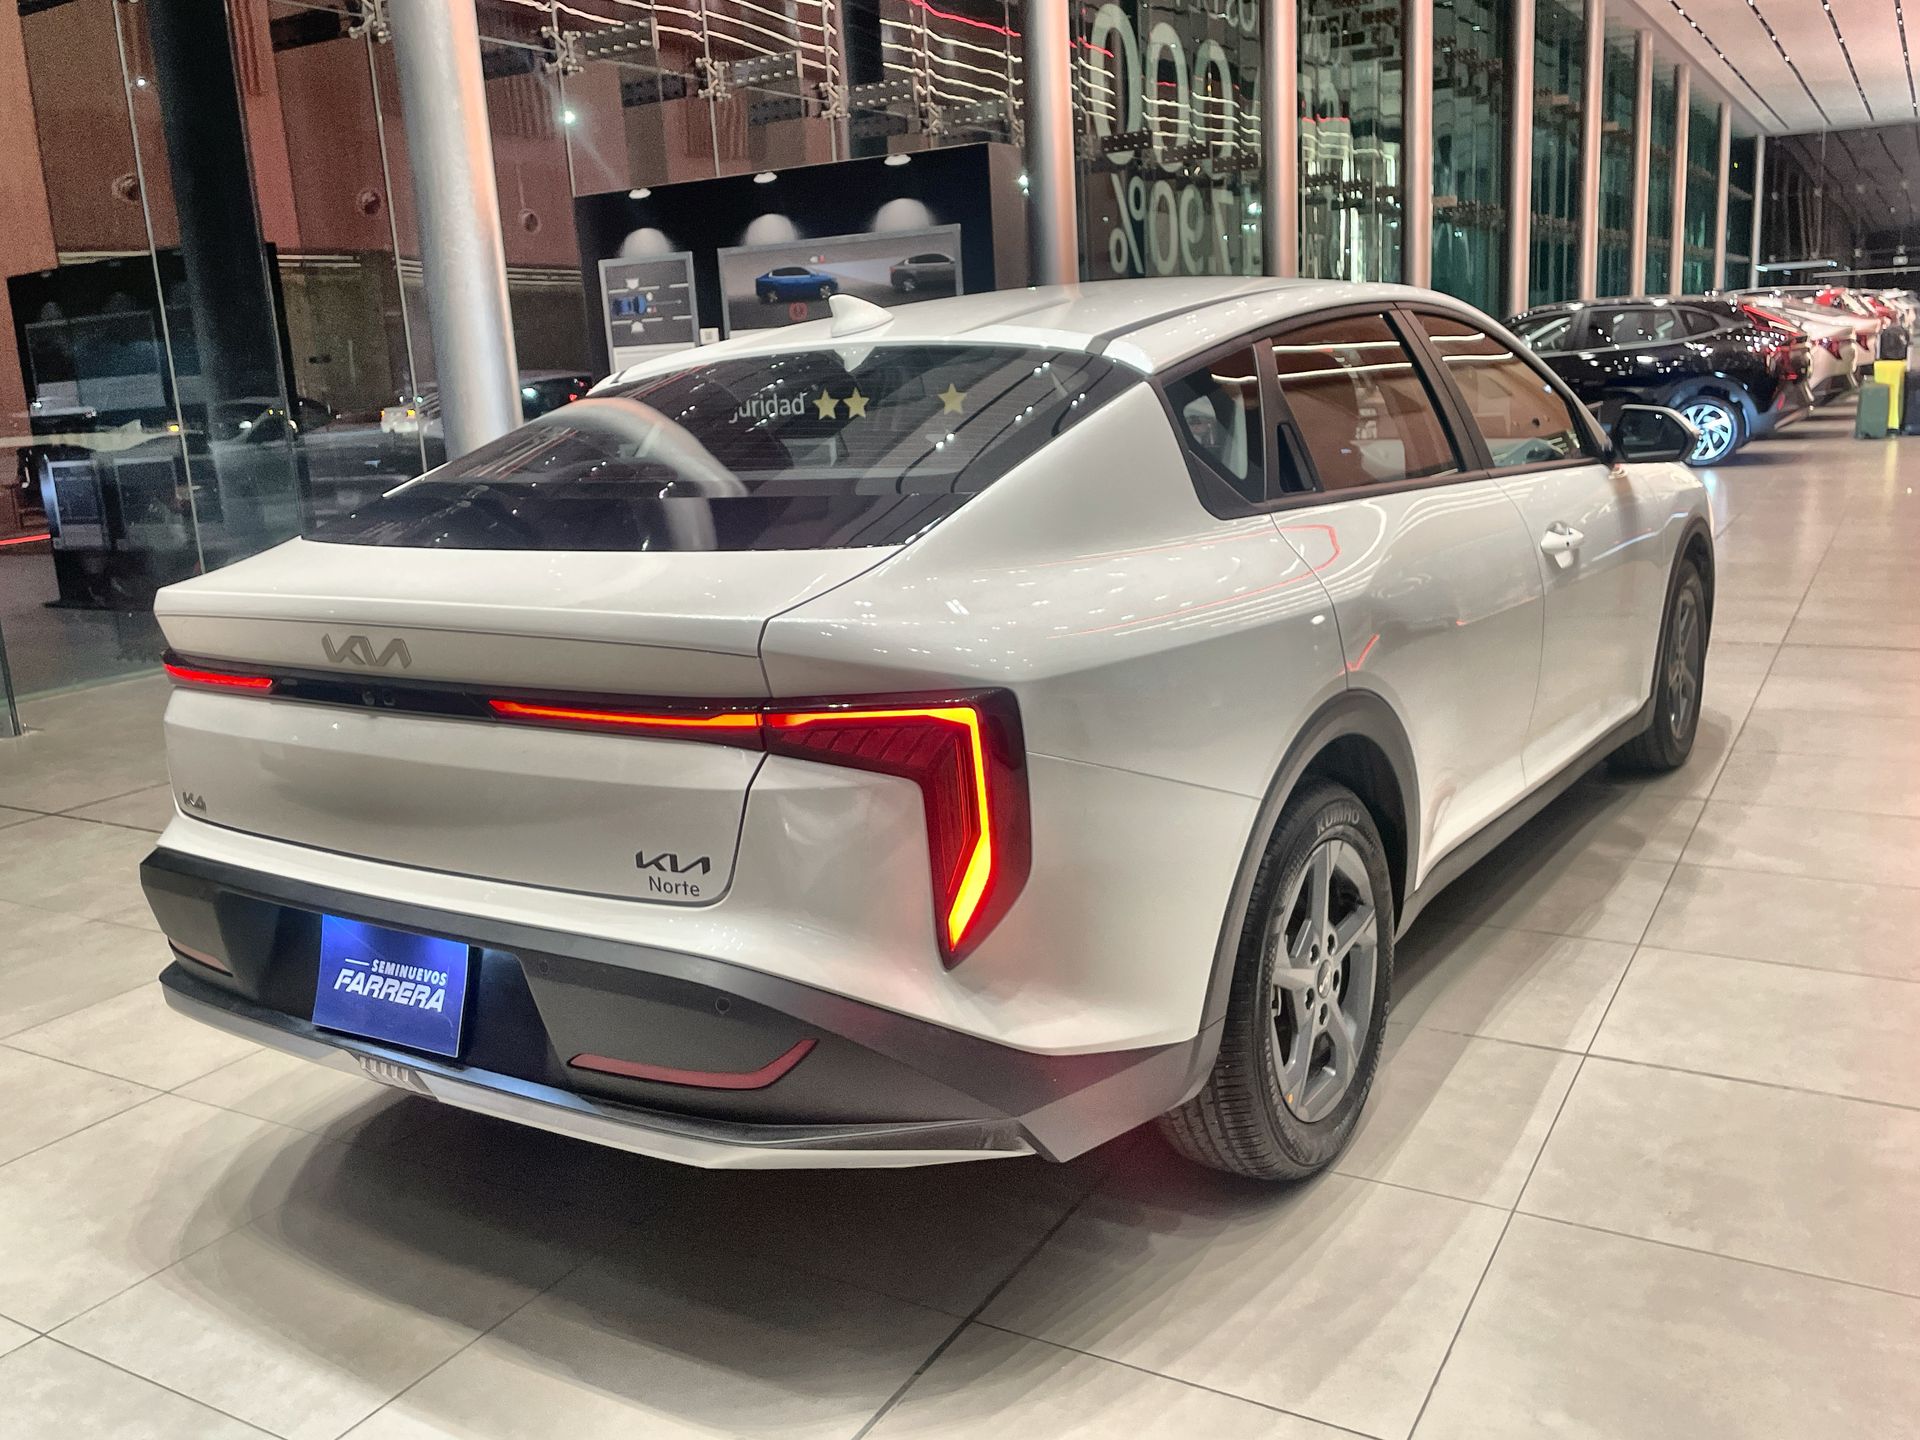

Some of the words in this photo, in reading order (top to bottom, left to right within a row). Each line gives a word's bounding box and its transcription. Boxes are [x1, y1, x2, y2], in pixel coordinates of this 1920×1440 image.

[321, 632, 412, 669] KIA
[635, 850, 711, 876] KIA
[648, 875, 700, 897] Norte
[371, 958, 449, 987] SEMINUEVOS
[333, 967, 446, 1013] FARRERA
